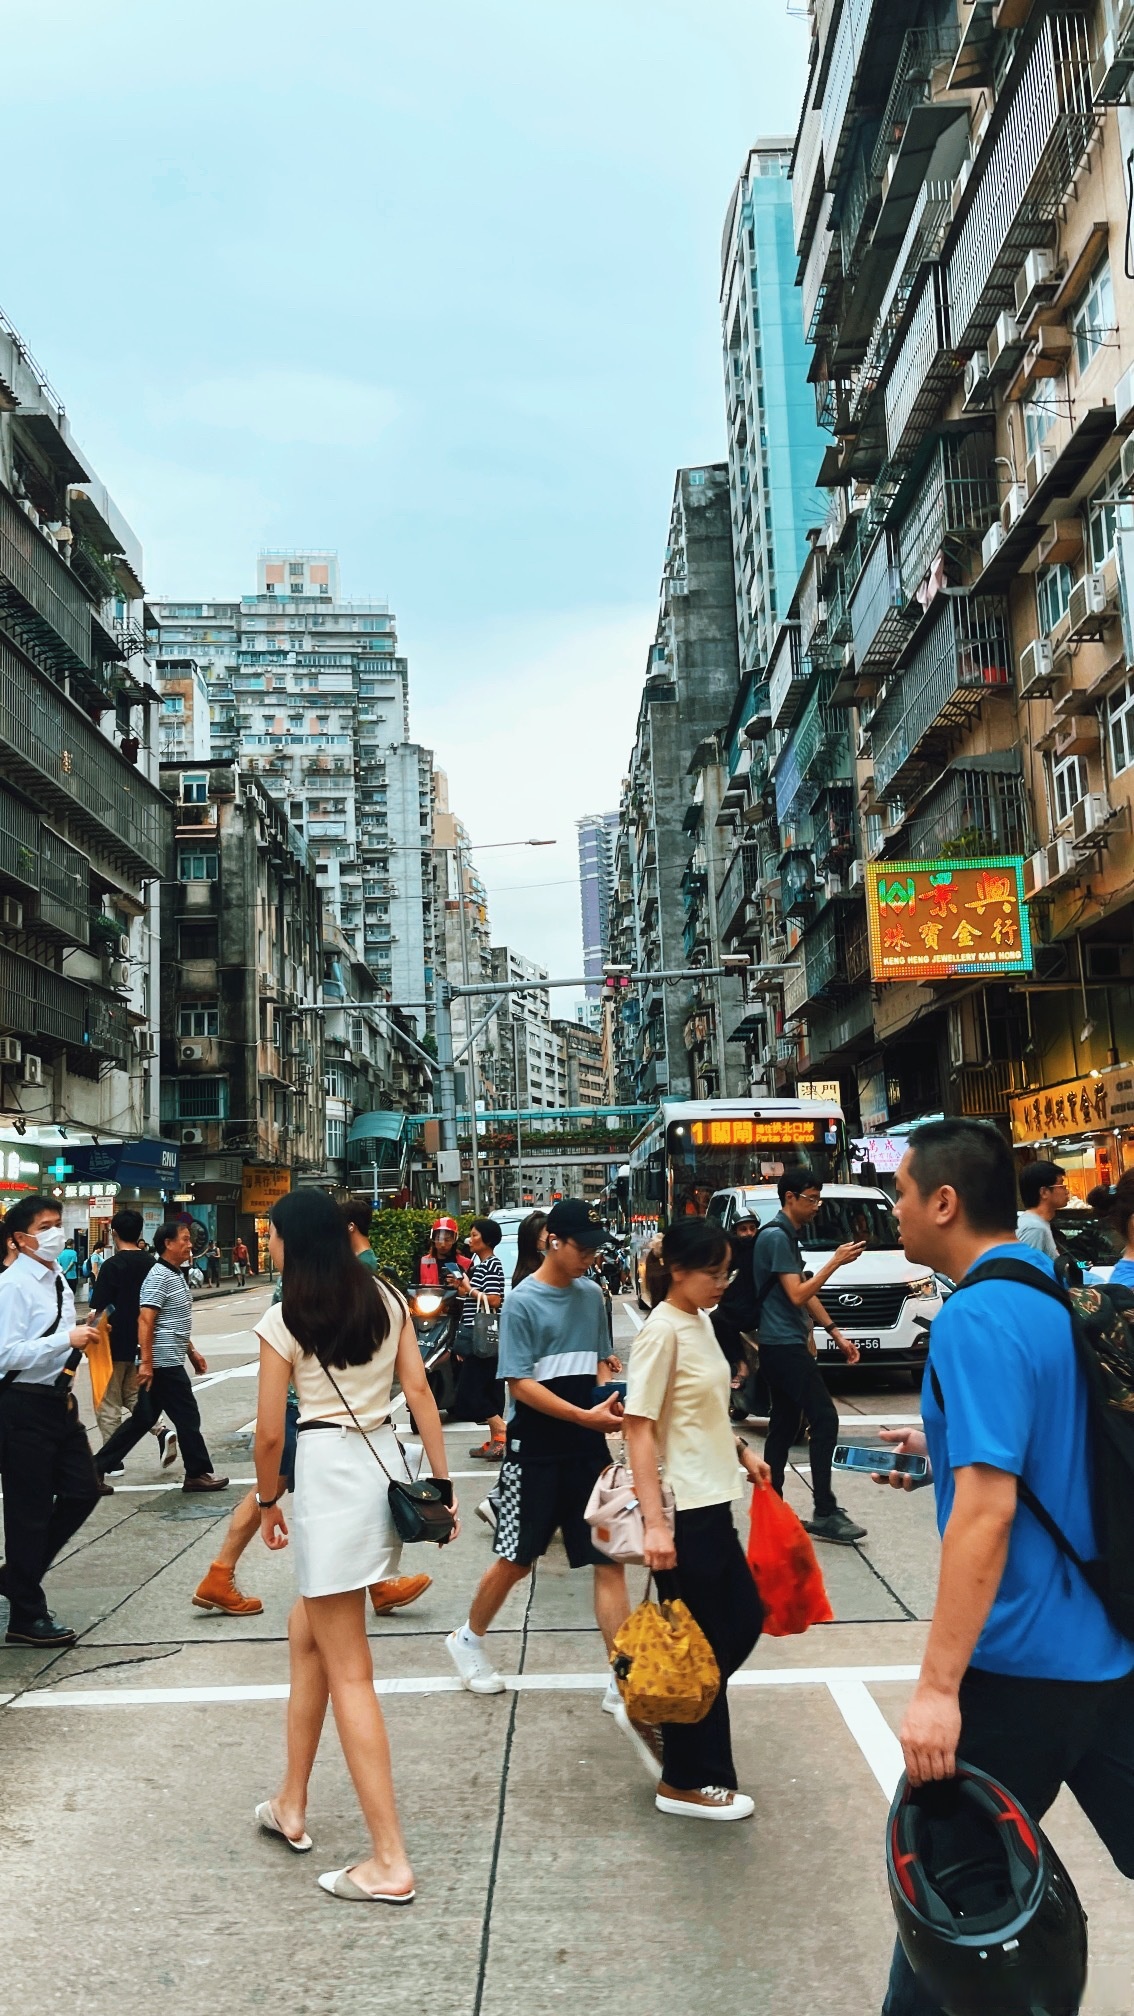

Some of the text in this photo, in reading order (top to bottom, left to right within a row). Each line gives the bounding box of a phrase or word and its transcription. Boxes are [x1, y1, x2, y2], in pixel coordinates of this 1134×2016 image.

[918, 871, 1017, 918] 景興
[883, 917, 1018, 952] 珠寶金行
[883, 950, 1022, 965] KENG HENG JEWELLERY KAM HONG
[801, 1084, 838, 1096] 澳門
[692, 1121, 703, 1144] 1
[161, 1150, 177, 1168] BNU
